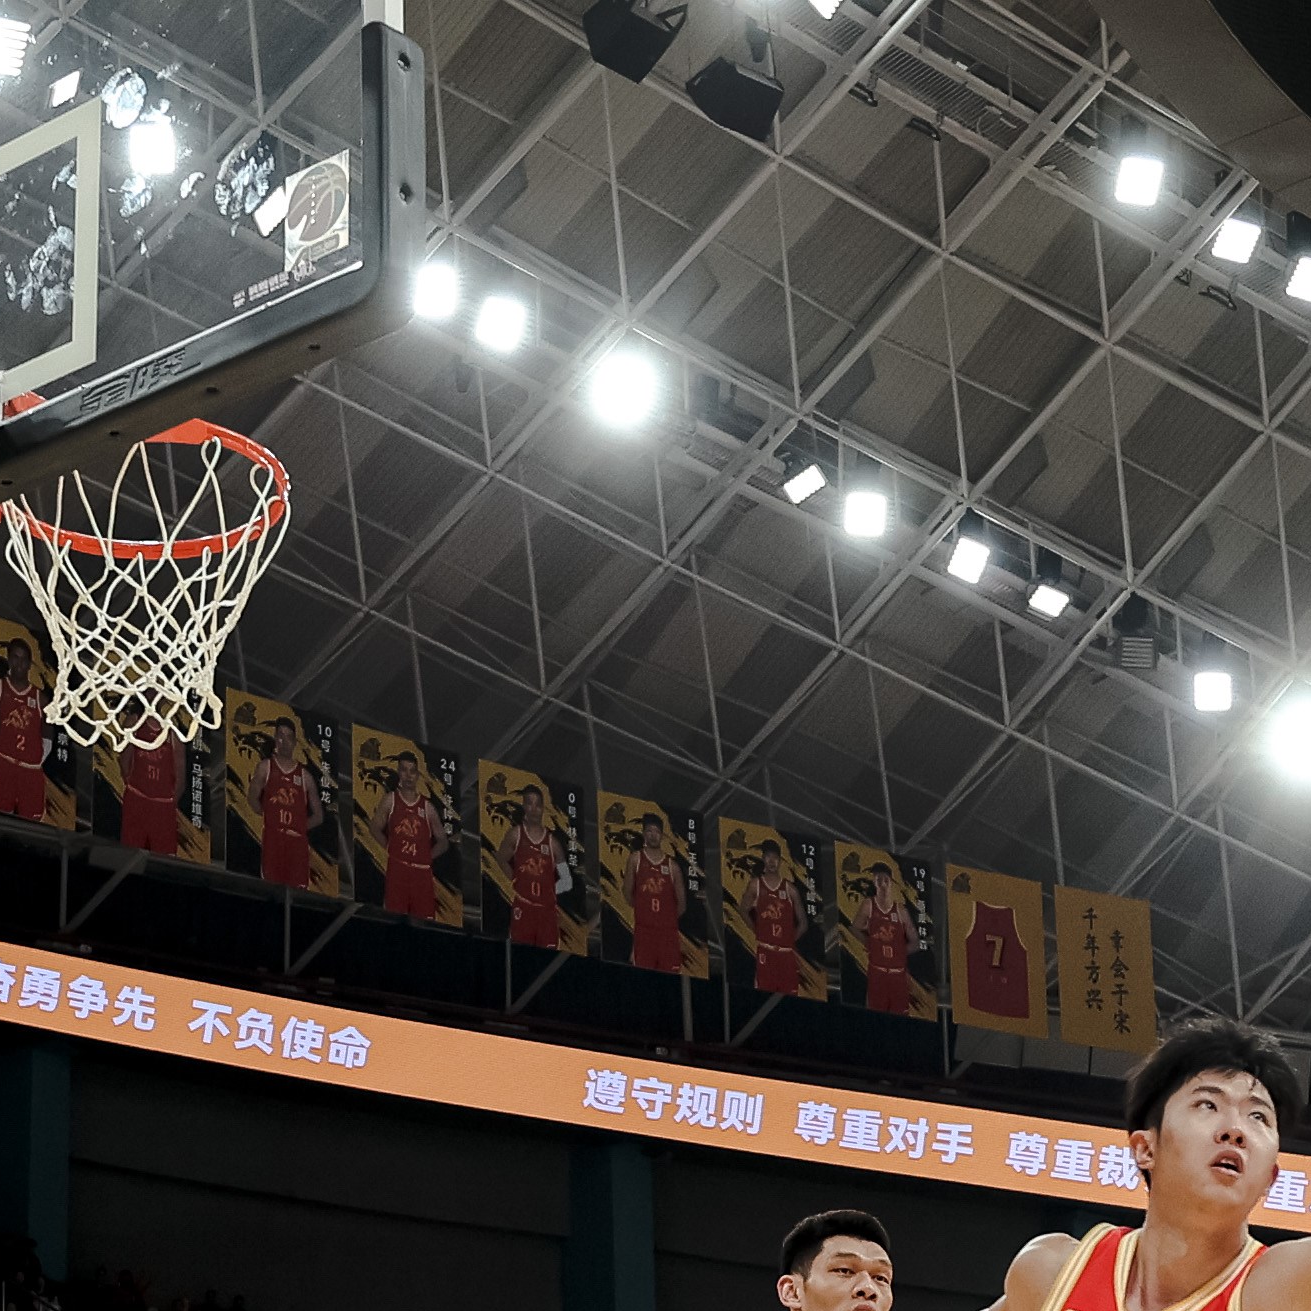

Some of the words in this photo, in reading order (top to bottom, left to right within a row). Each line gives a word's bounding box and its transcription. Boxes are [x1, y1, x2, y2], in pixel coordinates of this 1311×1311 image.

[985, 934, 1005, 969] 7
[187, 999, 372, 1069] 不负使命
[582, 1067, 765, 1135] 遵守规则
[792, 1100, 976, 1164] 尊重对手
[1005, 1131, 1149, 1192] 尊重裁
